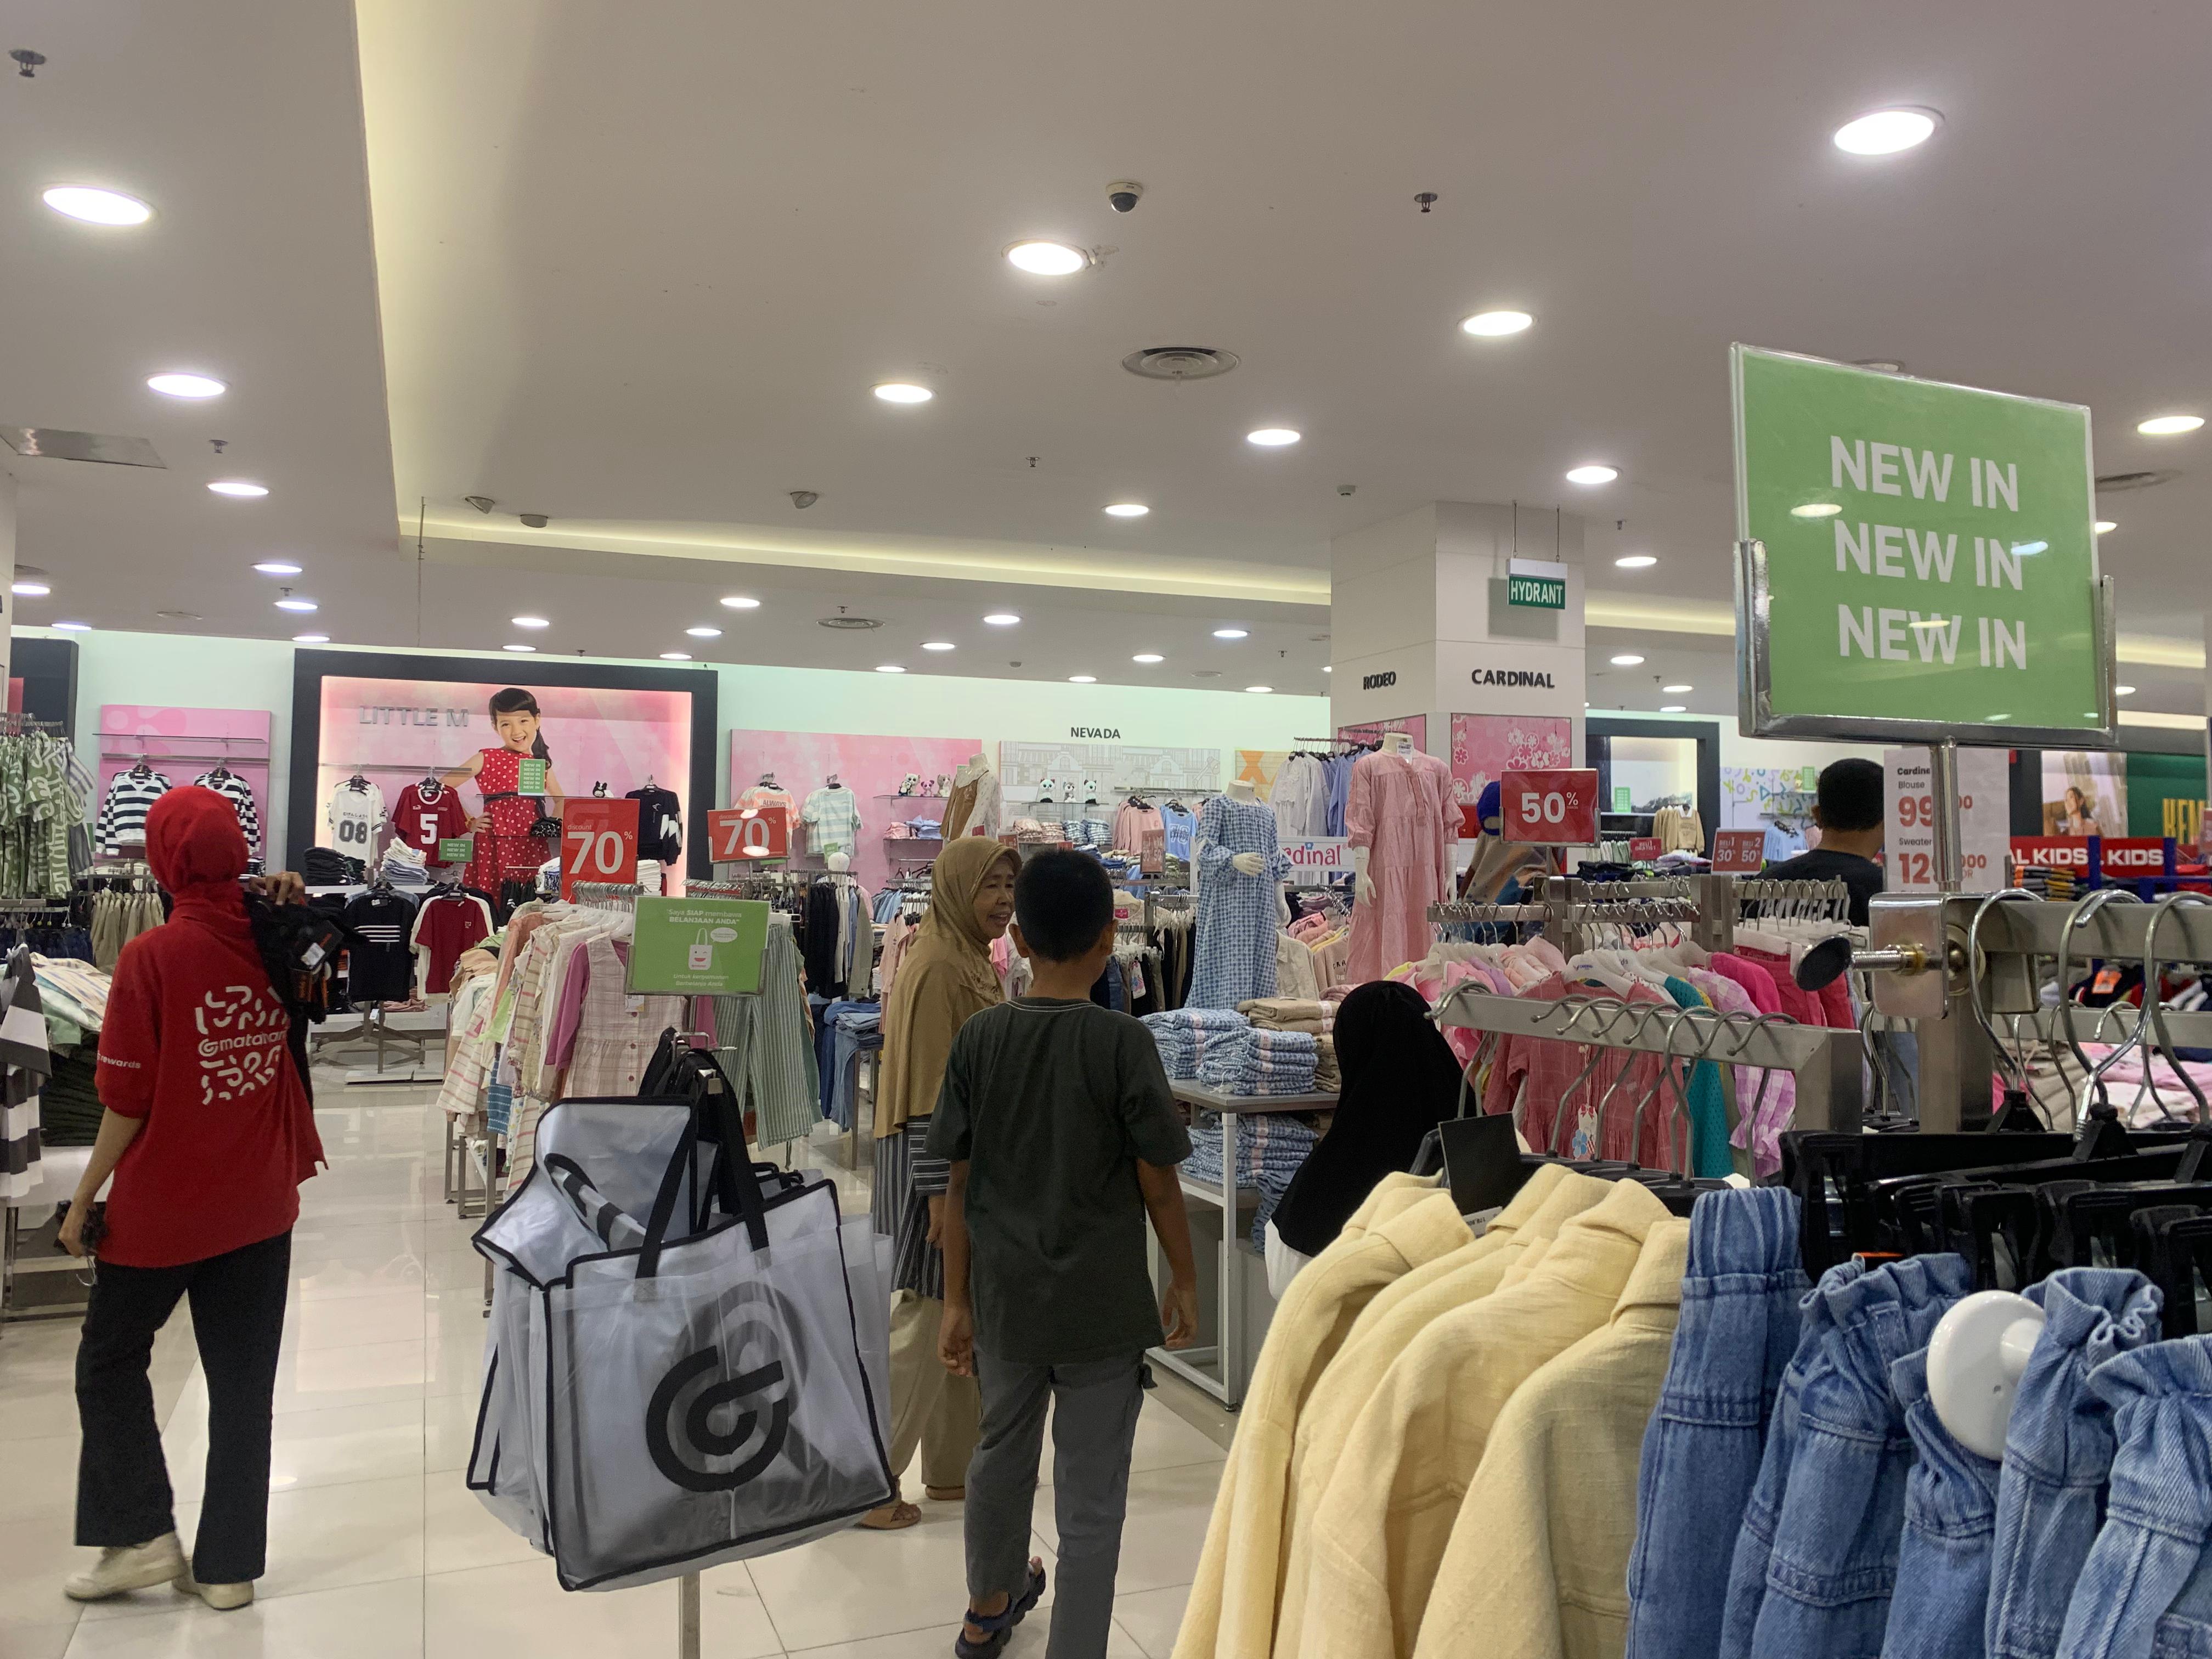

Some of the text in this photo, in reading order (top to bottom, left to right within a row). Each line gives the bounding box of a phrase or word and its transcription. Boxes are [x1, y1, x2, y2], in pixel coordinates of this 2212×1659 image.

[1831, 436, 2018, 512] NEW IN
[1834, 520, 2023, 590] NEW IN
[1511, 580, 1563, 604] HYDRANT
[1838, 604, 2026, 670] NEW IN
[1363, 672, 1396, 690] RODEO
[1471, 669, 1555, 689] CARDINAL
[359, 706, 468, 726] LITTLE M
[1071, 727, 1121, 738] NEVADA
[339, 820, 367, 844] 08
[420, 814, 438, 844] 5
[2033, 848, 2088, 865] KIDS
[2107, 849, 2164, 866] KIDS
[101, 1056, 141, 1069] rewards
